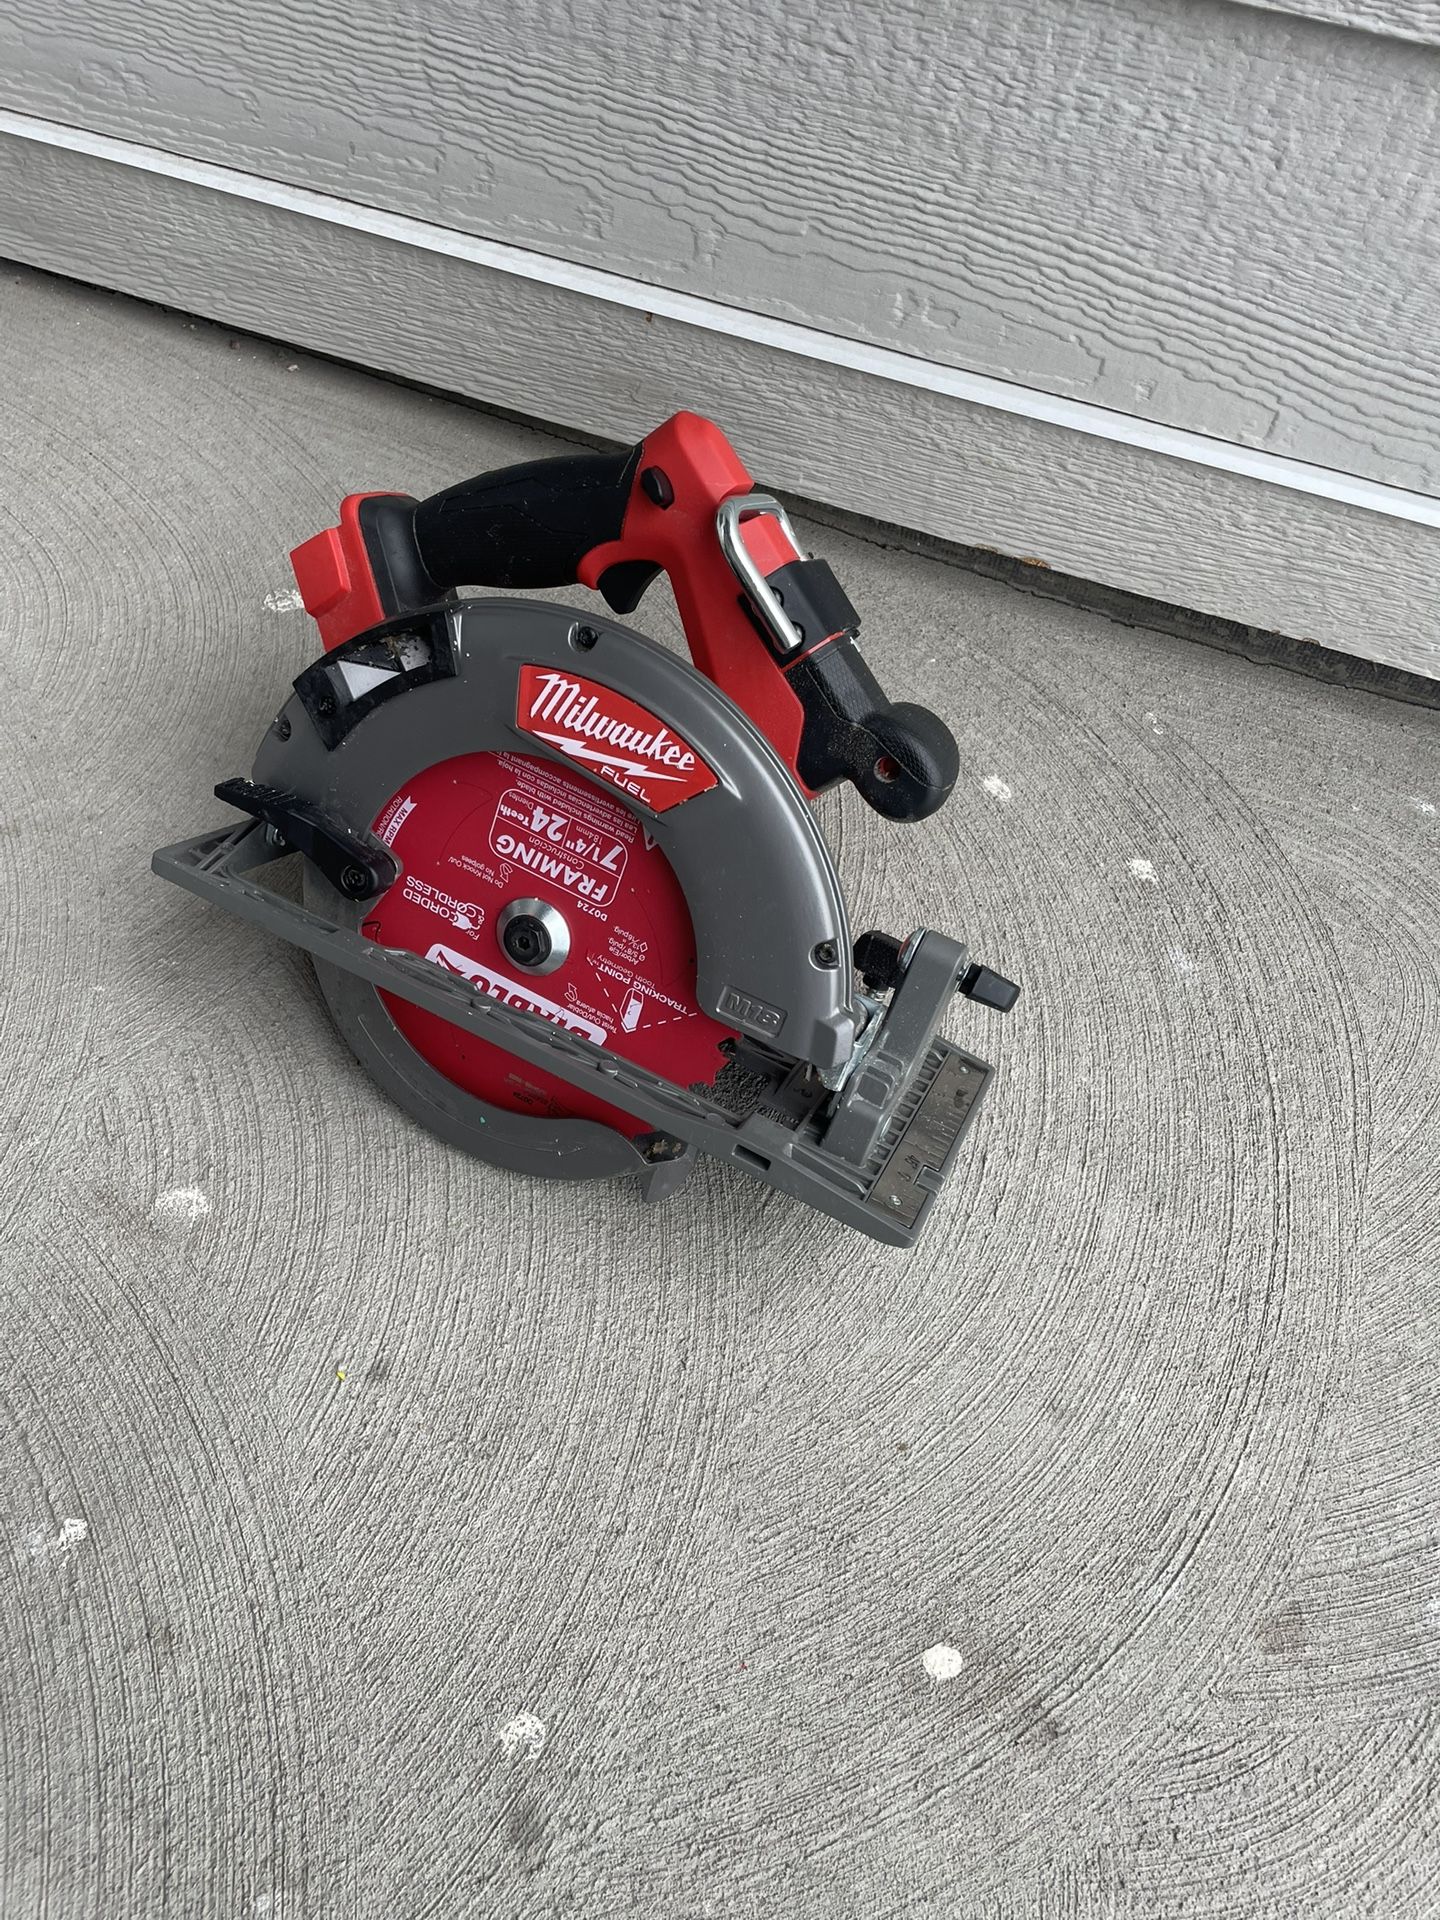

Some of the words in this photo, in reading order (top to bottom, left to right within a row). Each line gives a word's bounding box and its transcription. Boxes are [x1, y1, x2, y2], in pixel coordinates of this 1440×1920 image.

[530, 673, 695, 771] Milwaukee
[496, 759, 513, 773] hoja.
[511, 754, 562, 784] accompagnant
[514, 768, 521, 777] la
[522, 772, 535, 782] con
[600, 765, 650, 804] FUEL
[515, 779, 536, 796] blade.
[536, 778, 567, 799] incluidas
[537, 790, 552, 803] with
[562, 781, 614, 809] avertissements
[508, 791, 534, 810] Dientes
[552, 798, 582, 819] included
[568, 794, 612, 820] advertencias
[393, 807, 408, 826] MAX
[500, 804, 529, 826] Teeth
[615, 807, 626, 817] les
[530, 805, 568, 842] 24
[583, 813, 614, 834] warnings
[613, 818, 623, 827] las
[625, 822, 638, 834] Lea
[383, 824, 397, 845] RPM
[575, 826, 603, 845] 184mm
[615, 830, 634, 844] Read
[528, 836, 585, 870] Construcción
[462, 862, 482, 878] Knock
[485, 868, 495, 877] No
[496, 834, 608, 902] FRAMING
[482, 873, 494, 884] Not
[494, 880, 504, 888] Do
[402, 888, 457, 922] CORDED
[576, 900, 608, 922] D0724
[465, 930, 480, 941] For
[608, 946, 639, 966] Arbor/Eje
[597, 954, 634, 978] Geometry
[635, 974, 656, 989] Tooth
[632, 980, 688, 1015] TRACKING
[566, 1003, 600, 1026] Out/Doblar
[575, 1000, 596, 1016] afuera
[596, 1010, 614, 1024] hacia
[602, 1021, 618, 1034] Twist
